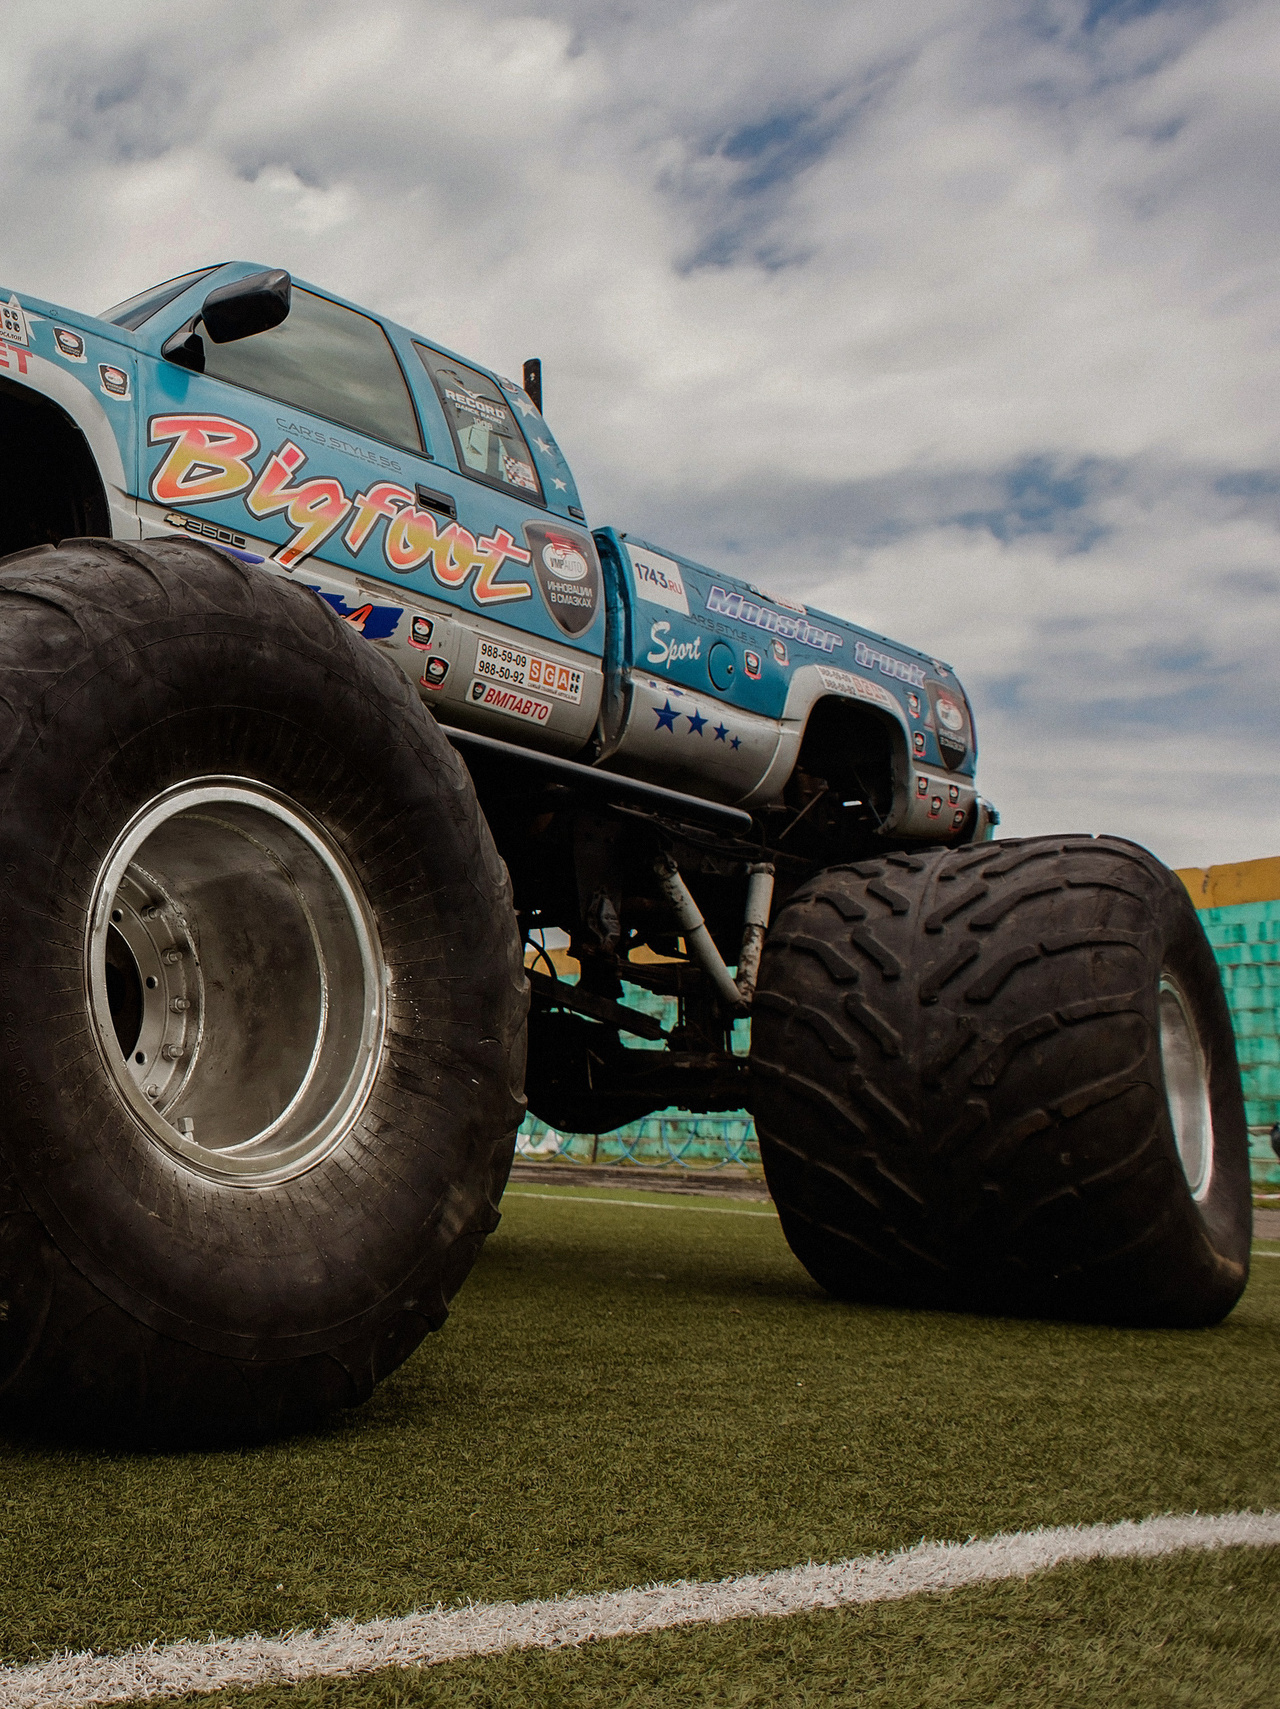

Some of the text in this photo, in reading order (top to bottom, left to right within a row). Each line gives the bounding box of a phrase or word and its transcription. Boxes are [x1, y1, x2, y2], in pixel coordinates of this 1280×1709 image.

[444, 388, 506, 420] RECORD
[276, 418, 326, 443] CAR'S
[330, 437, 377, 462] STYLE
[147, 412, 532, 606] Bigfoot
[185, 521, 246, 549] 3500
[546, 580, 593, 598] ИННОВАЦИИ
[550, 592, 593, 609] В СМАЗКАХ
[647, 620, 703, 669] Sport
[706, 585, 844, 654] Monster
[855, 641, 926, 690] truck
[481, 643, 527, 668] 988-59-09
[478, 660, 525, 684] 988-50-92
[530, 661, 568, 689] SGA
[483, 688, 549, 720] ВМПАВТО
